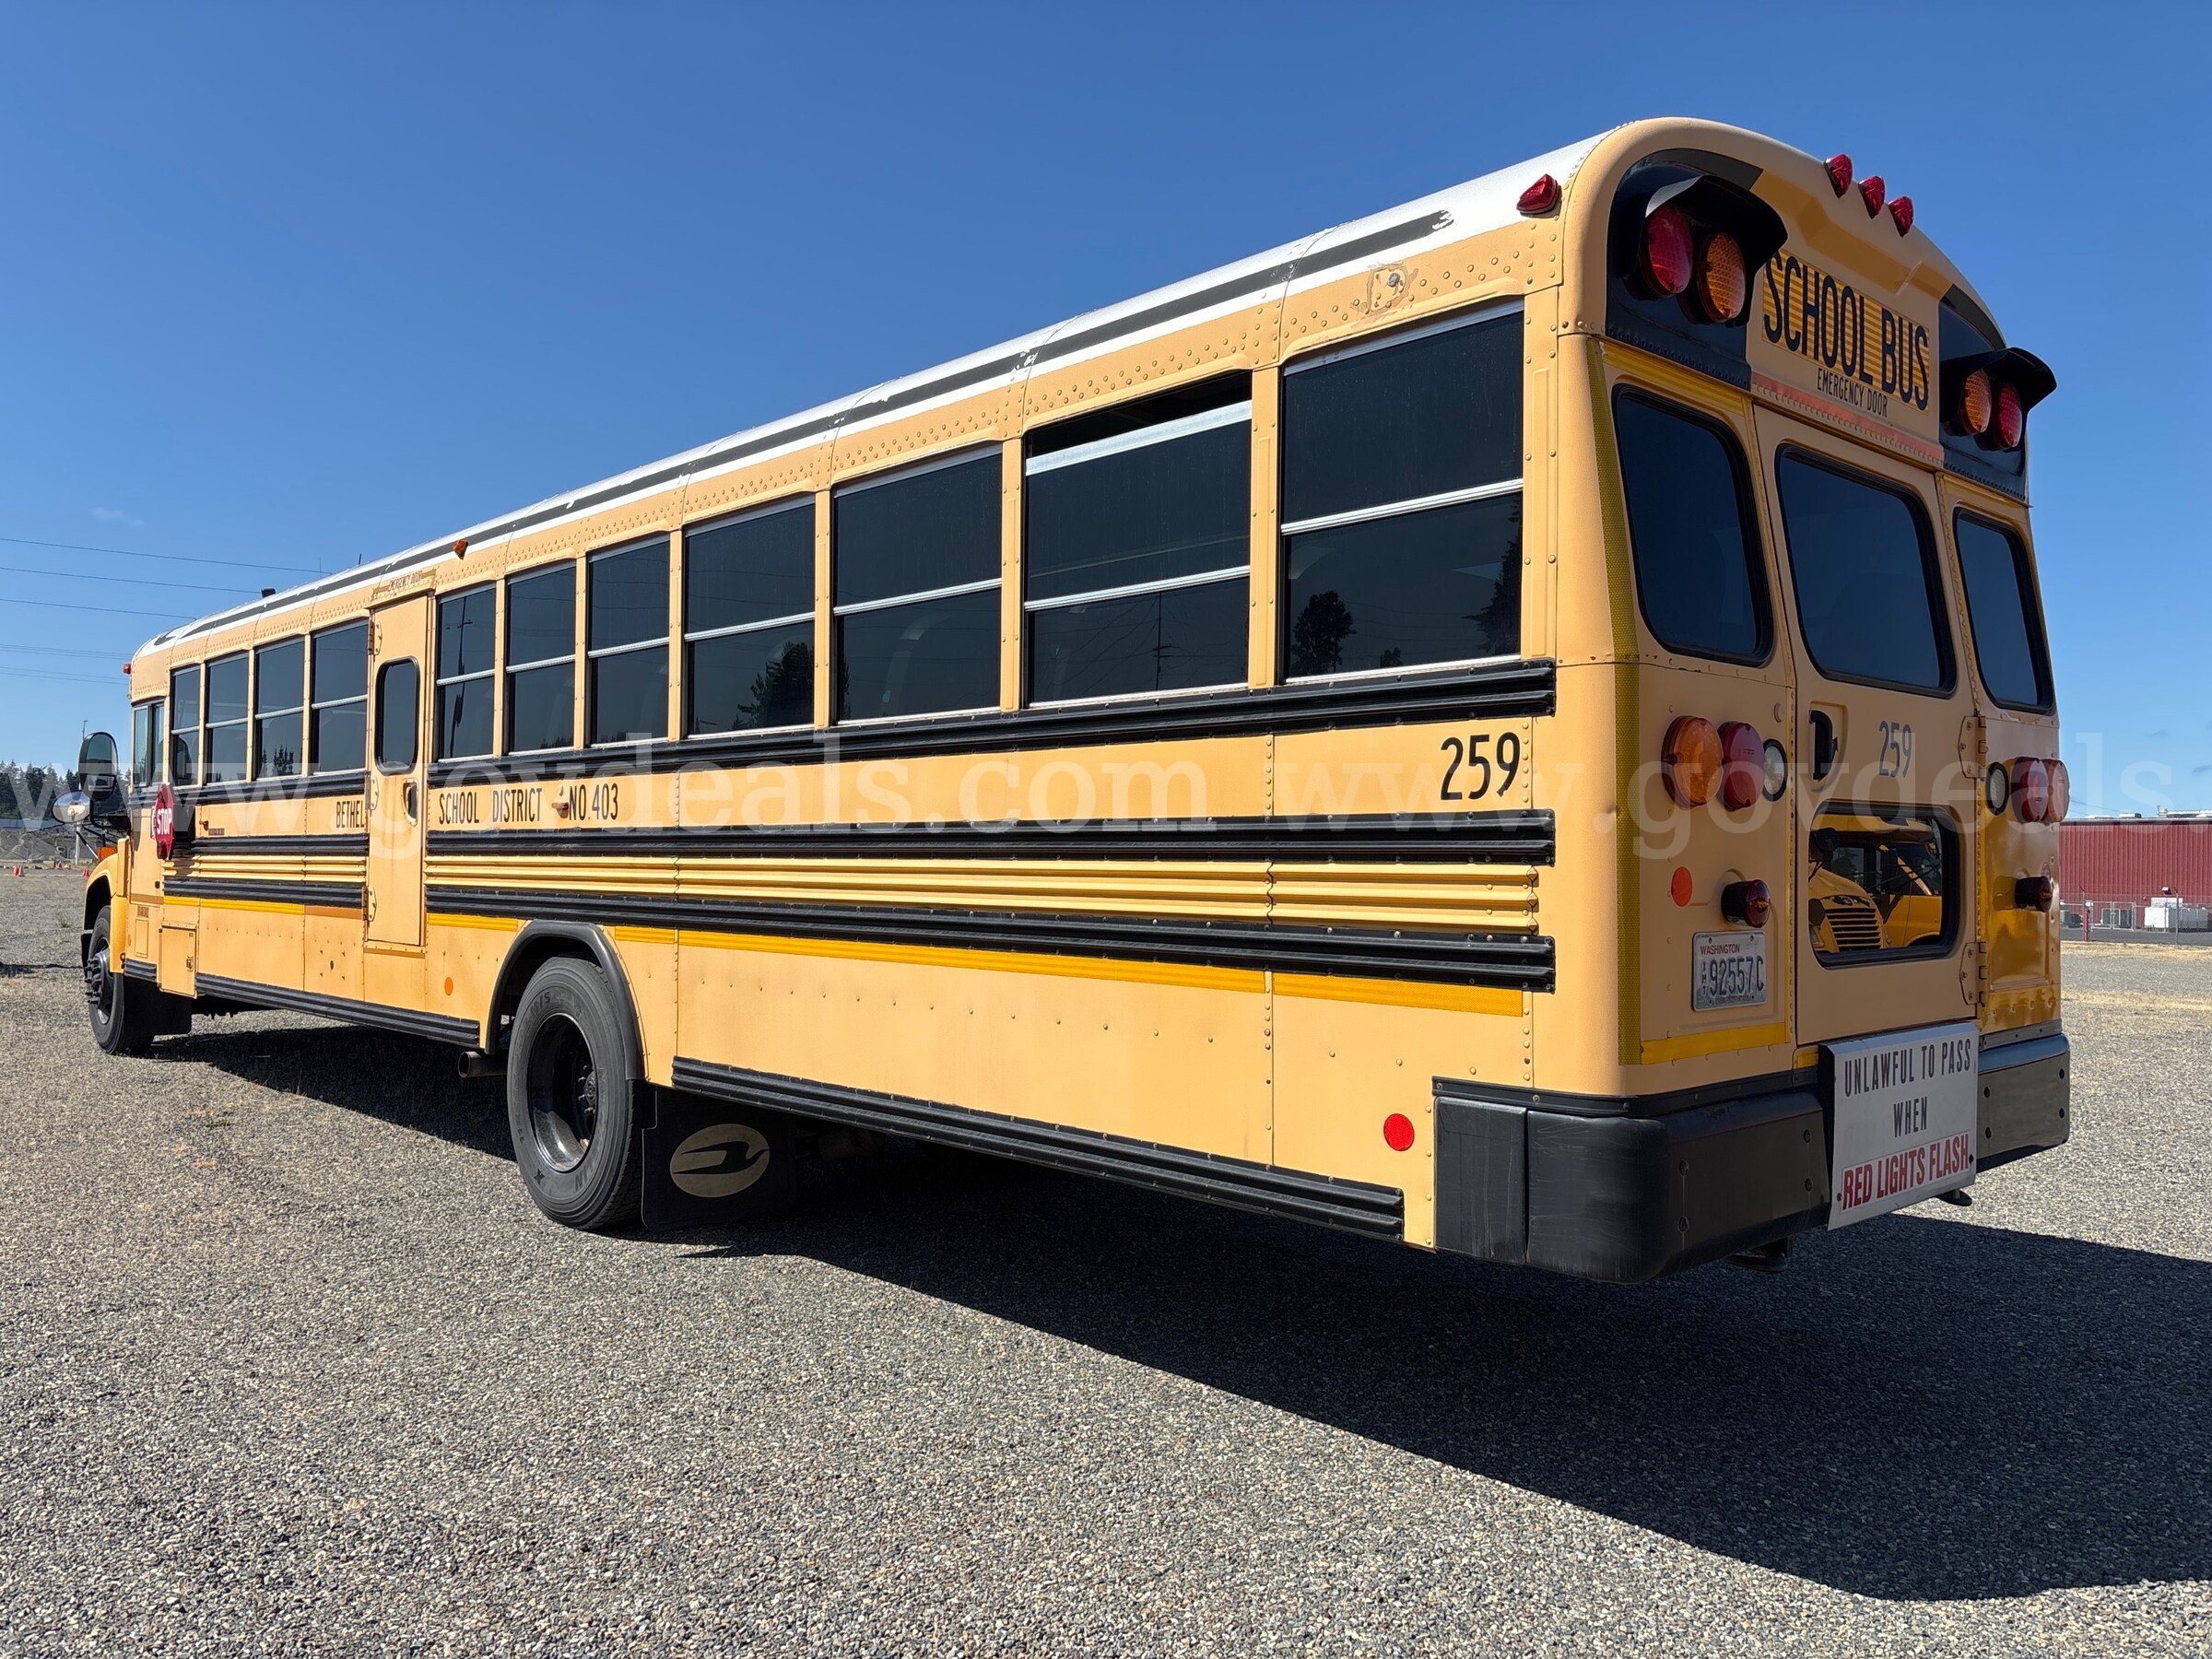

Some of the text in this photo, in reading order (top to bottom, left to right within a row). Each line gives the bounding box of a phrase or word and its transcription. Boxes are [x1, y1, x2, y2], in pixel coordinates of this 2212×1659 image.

[1764, 250, 1929, 411] SCHOOL BUS
[1817, 368, 1888, 418] EMERGENCY DOOR
[1440, 732, 1521, 800] 259
[1878, 720, 1912, 779] 259
[157, 807, 172, 835] STOP
[335, 800, 365, 829] BETHEL
[439, 791, 479, 825] SCHOOL
[492, 788, 543, 823] DISTRICT
[1700, 944, 1741, 956] WASHINGTON
[1710, 955, 1765, 996] 92557C
[1844, 1038, 1971, 1097] UNLAWFUL TO PASS
[1893, 1096, 1928, 1138] WHEN
[1842, 1134, 1969, 1210] RED LIGHTS FLASH
